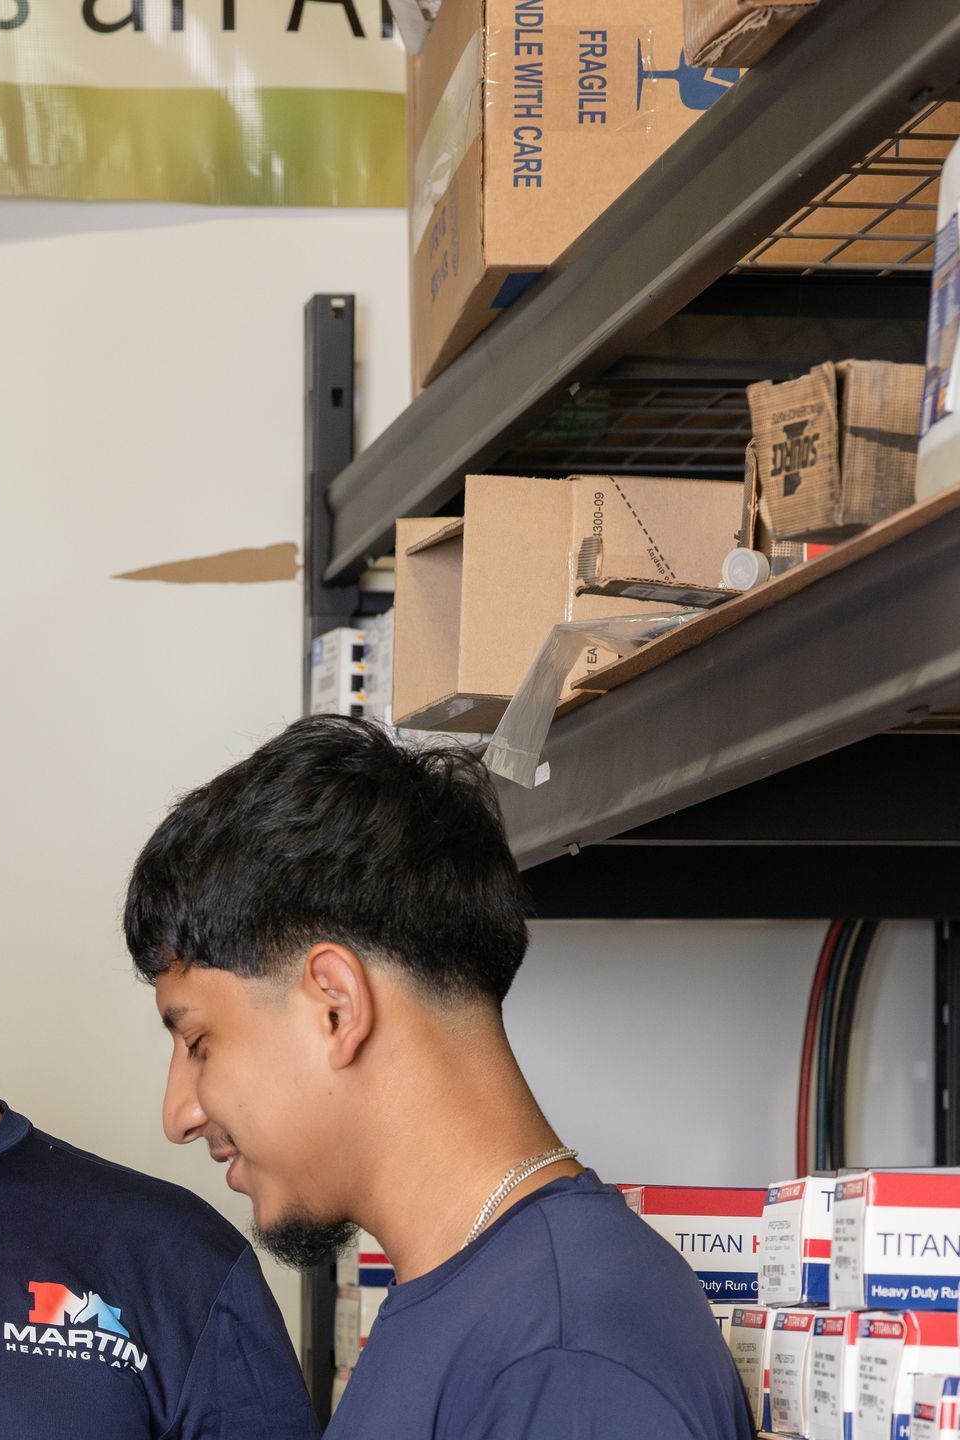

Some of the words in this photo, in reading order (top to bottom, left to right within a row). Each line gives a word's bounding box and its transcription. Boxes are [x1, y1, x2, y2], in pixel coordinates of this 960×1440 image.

[578, 30, 607, 124] FRAGILE
[514, 62, 543, 118] WITH
[513, 126, 543, 188] CARE
[586, 647, 598, 664] EA
[675, 1233, 742, 1253] TITAN
[877, 1232, 960, 1257] TITAN
[725, 1280, 747, 1291] Run
[872, 1284, 909, 1300] Heavy
[911, 1286, 939, 1300] Duty
[3, 1322, 148, 1371] MARTIN
[6, 1342, 91, 1360] HEATING
